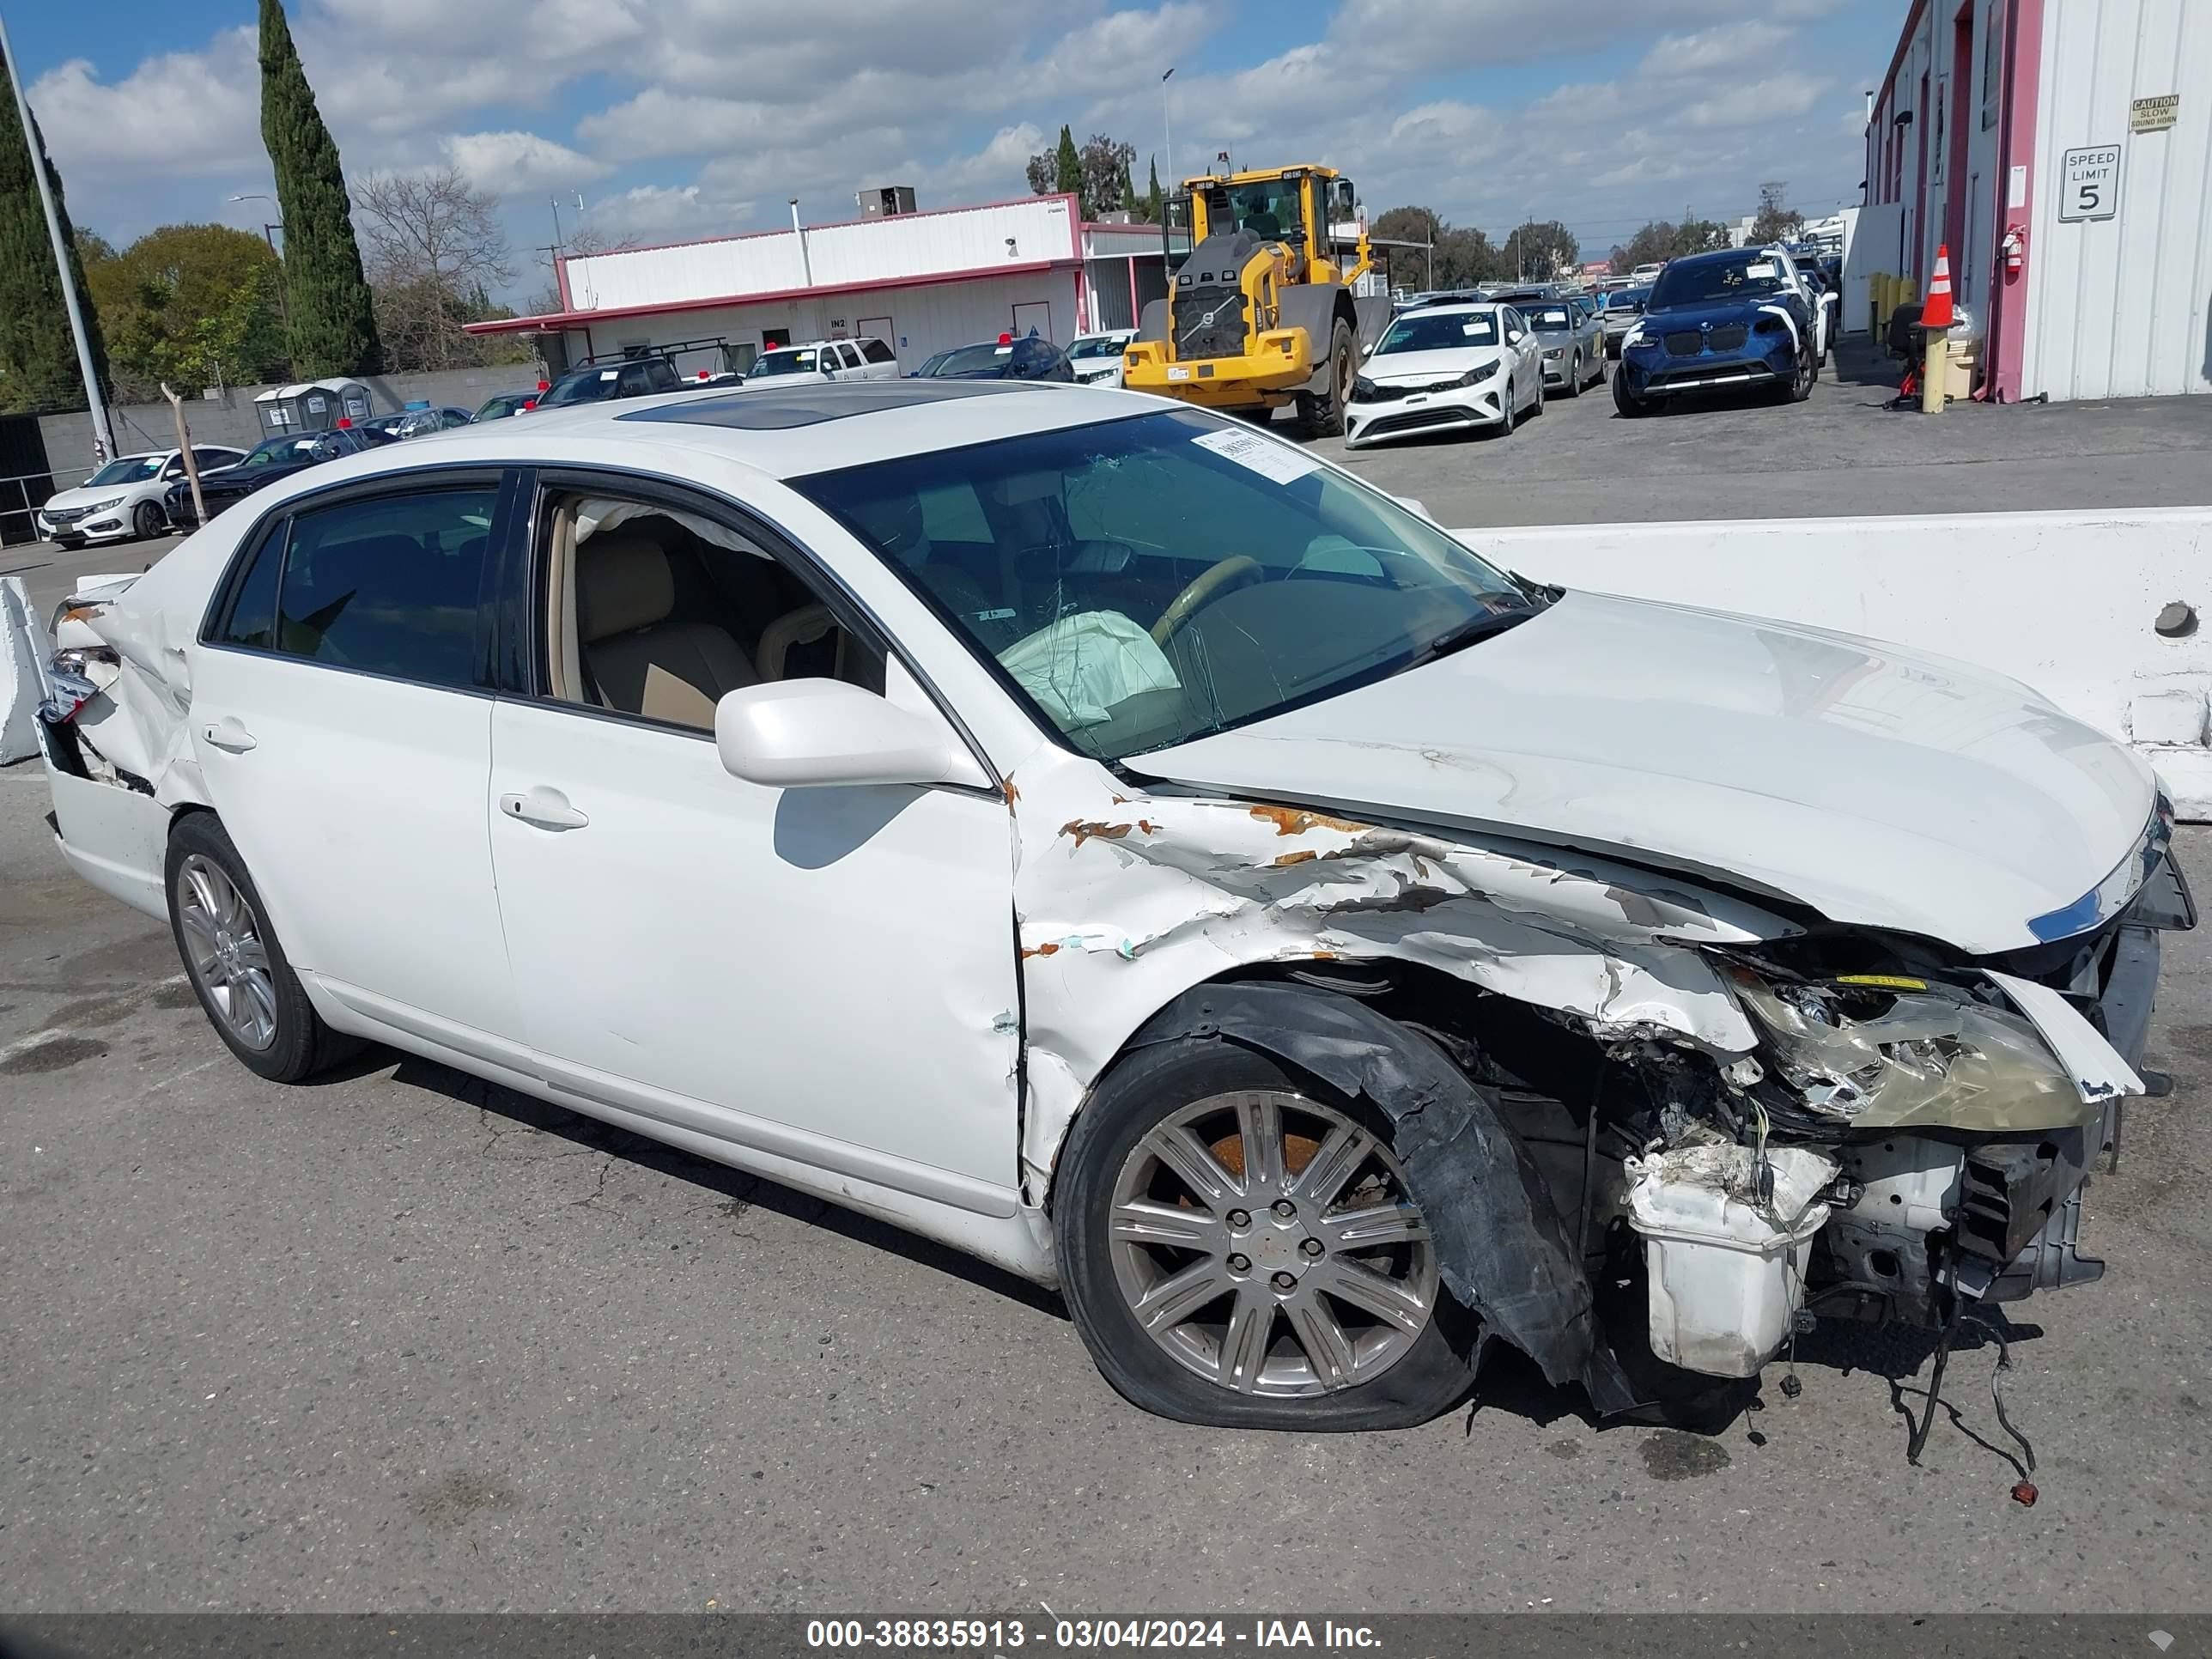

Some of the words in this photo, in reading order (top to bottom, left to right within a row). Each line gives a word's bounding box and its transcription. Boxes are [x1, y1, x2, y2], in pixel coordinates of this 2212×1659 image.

[2134, 95, 2178, 110] CAUTION
[2140, 108, 2169, 118] SLOW
[2131, 118, 2155, 128] SOUND
[2157, 116, 2177, 125] HORN
[2069, 153, 2116, 167] SPEED
[2072, 168, 2110, 181] LIMIT
[2078, 184, 2100, 210] 5
[831, 319, 845, 328] IN2
